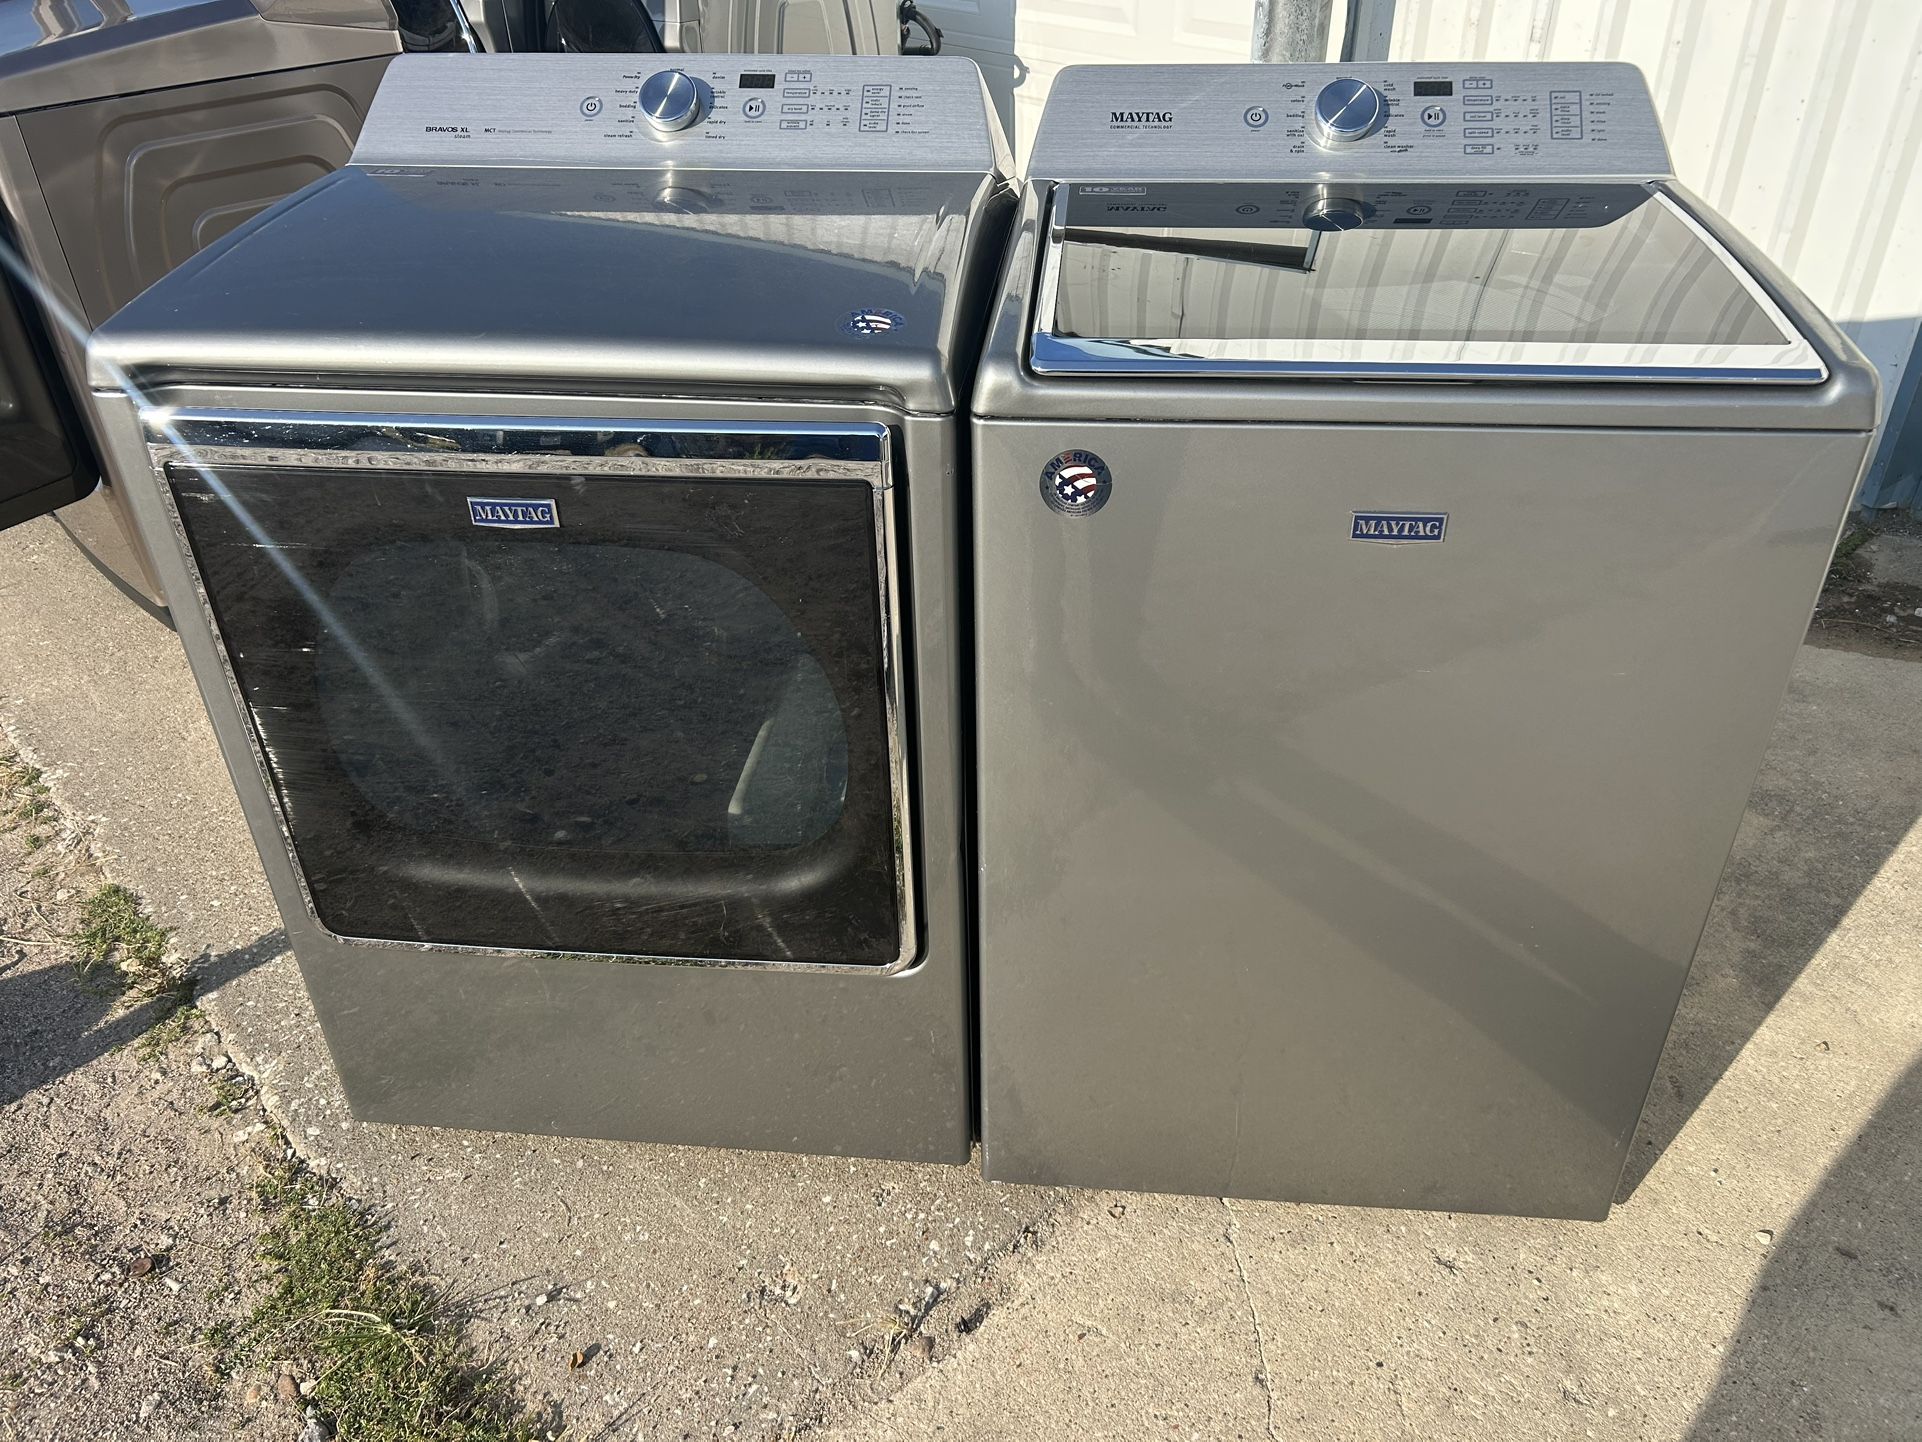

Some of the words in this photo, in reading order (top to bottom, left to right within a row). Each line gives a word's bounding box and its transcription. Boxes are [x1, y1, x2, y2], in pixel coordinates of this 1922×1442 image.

[1110, 112, 1173, 123] MAYTAG
[1045, 451, 1105, 481] AMERICA
[474, 505, 551, 521] MAYTAG
[1355, 519, 1440, 536] MAYTAG
